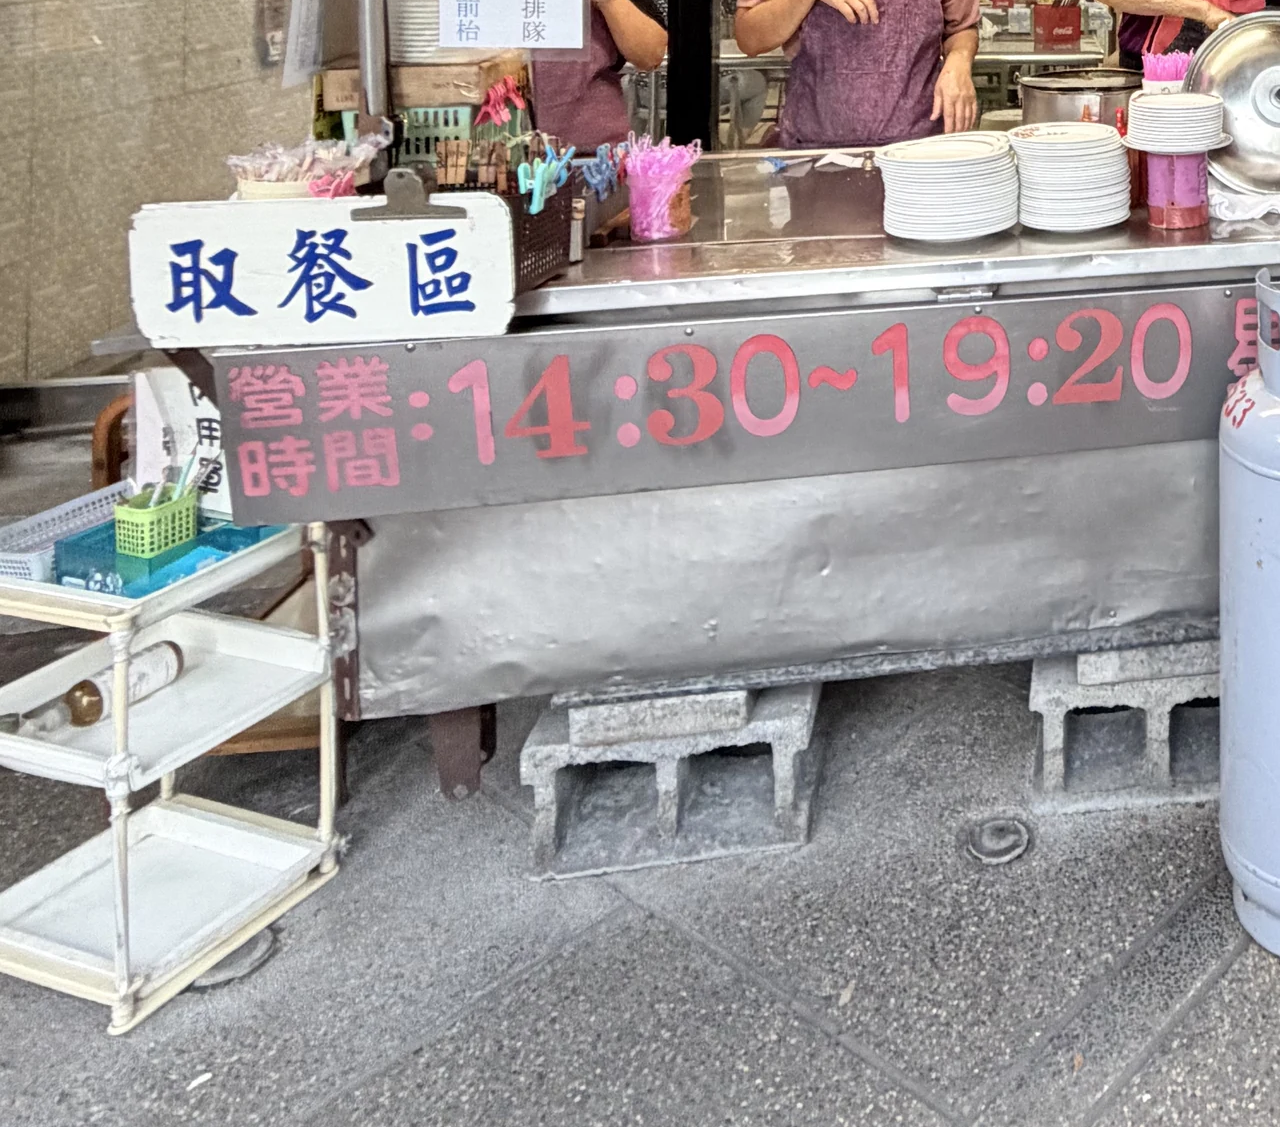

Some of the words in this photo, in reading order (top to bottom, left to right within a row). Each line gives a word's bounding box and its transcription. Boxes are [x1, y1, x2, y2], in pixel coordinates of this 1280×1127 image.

[164, 227, 477, 324] 取餐區
[228, 356, 395, 431] 營業
[237, 426, 401, 498] 時間
